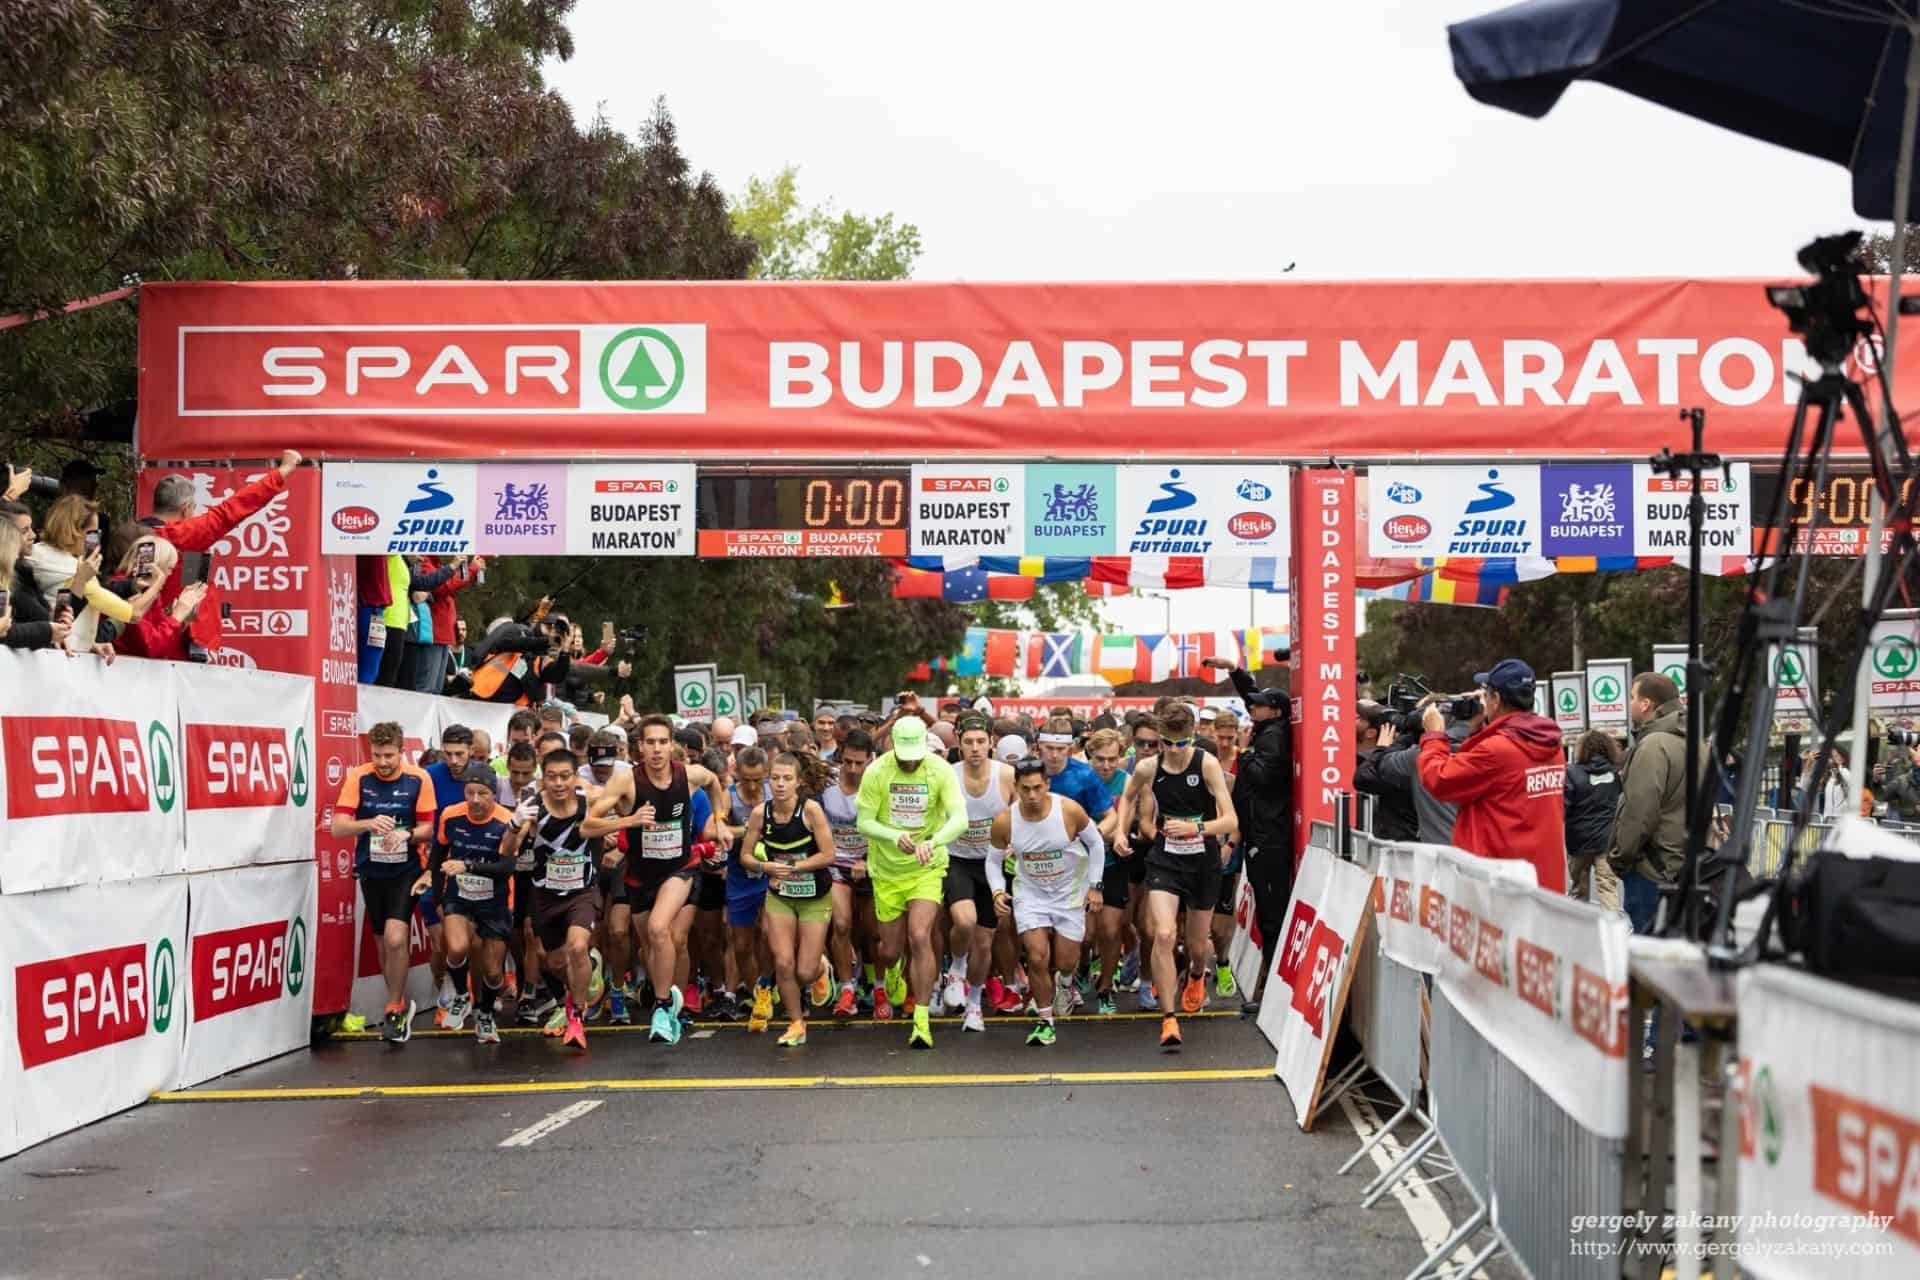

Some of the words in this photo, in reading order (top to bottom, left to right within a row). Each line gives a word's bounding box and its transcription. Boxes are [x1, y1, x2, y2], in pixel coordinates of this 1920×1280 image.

[262, 346, 569, 396] SPAR
[769, 340, 1307, 408] BUDAPEST
[607, 481, 663, 492] SPAR
[935, 479, 991, 490] SPAR
[1660, 481, 1718, 491] SPR
[804, 479, 904, 526] 0:00
[506, 505, 539, 520] 150
[590, 505, 681, 522] BUDAPEST
[919, 503, 1010, 519] BUDAPEST
[1055, 505, 1088, 521] 150
[1572, 506, 1606, 521] 150
[1647, 504, 1739, 520] BUDAEST
[336, 512, 376, 529] Hervis
[393, 519, 464, 535] SPURI
[1136, 519, 1208, 536] SPURI
[1233, 519, 1273, 533] Hervis
[1388, 521, 1428, 536] Hervis
[1454, 520, 1526, 536] SPURI
[484, 523, 557, 536] BUDAPEST
[921, 529, 1005, 546] MARATON
[1034, 525, 1107, 537] BUDAPEST
[1551, 525, 1625, 537] BUDAPEST
[387, 537, 469, 552] FUTÓBOLT
[592, 531, 676, 549] MARATON
[737, 533, 784, 543] SPAR
[809, 532, 884, 544] BUDAPEST
[1129, 538, 1212, 553] FUTÓBOLT
[1448, 538, 1532, 553] FUTÓBOLT
[1648, 530, 1734, 547] MARTON
[806, 543, 882, 556] FESZTIVÁL
[1321, 489, 1341, 651] BUDAPEST
[214, 566, 309, 591] APEST
[1872, 682, 1920, 693] SPAR
[1319, 663, 1343, 805] MARATON
[31, 735, 147, 798] SPAR
[208, 740, 289, 794] SPAR
[898, 795, 920, 804] 5194
[212, 935, 283, 1001] SPAR
[42, 962, 146, 1044] SPAR
